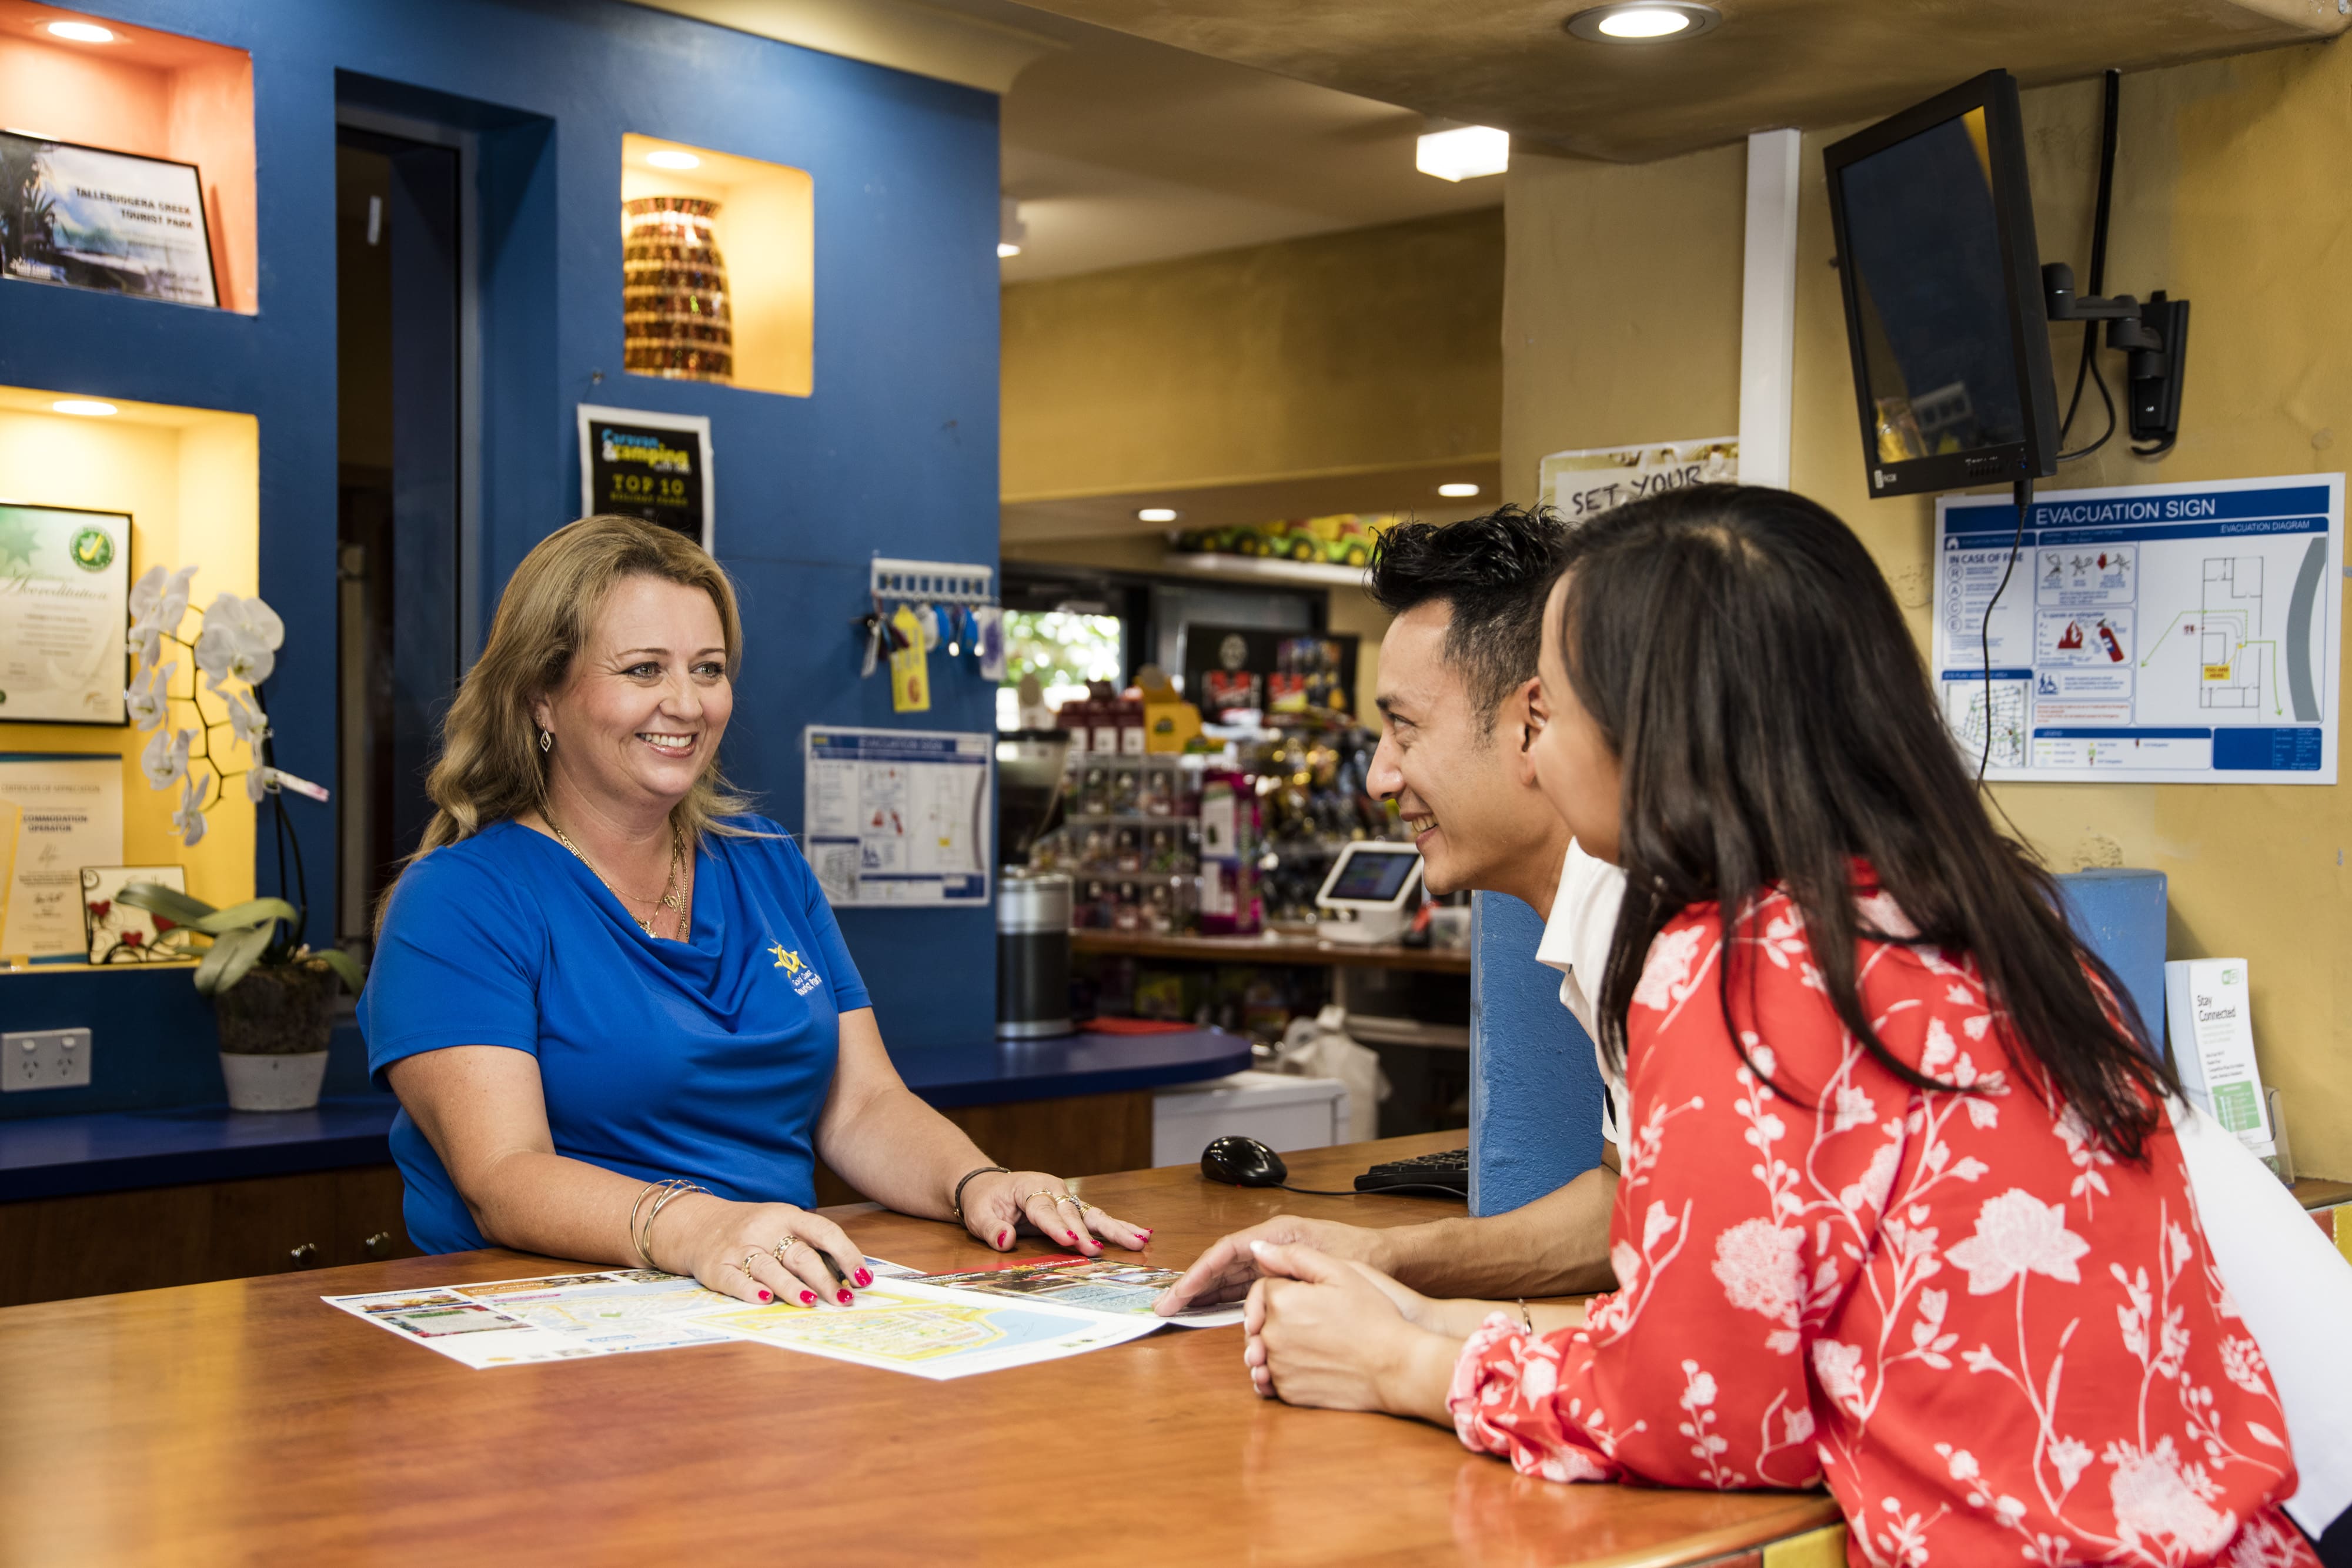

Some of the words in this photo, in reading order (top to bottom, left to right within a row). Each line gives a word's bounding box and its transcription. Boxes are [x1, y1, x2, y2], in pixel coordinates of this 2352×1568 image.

[76, 186, 155, 209] TALLEBUDGERA
[158, 202, 191, 215] CREEK
[121, 209, 162, 224] TOURIST
[166, 218, 193, 229] PARK
[612, 473, 654, 493] TOP
[660, 479, 685, 496] 10
[1572, 483, 1620, 515] SET
[1631, 465, 1703, 499] YOUR
[2036, 502, 2160, 525] EVACUATION
[2166, 498, 2216, 517] SIGN
[2221, 522, 2271, 533] EVACUATION
[2273, 520, 2310, 530] DIAGRAM
[1949, 556, 1960, 564] IN
[1962, 554, 1986, 563] CASE
[1987, 553, 2000, 562] OF
[28, 824, 72, 833] OPERATOR
[794, 983, 814, 997] Tourist
[2196, 994, 2213, 1007] Stay
[2199, 1007, 2237, 1022] Connected
[498, 1282, 544, 1290] shopping
